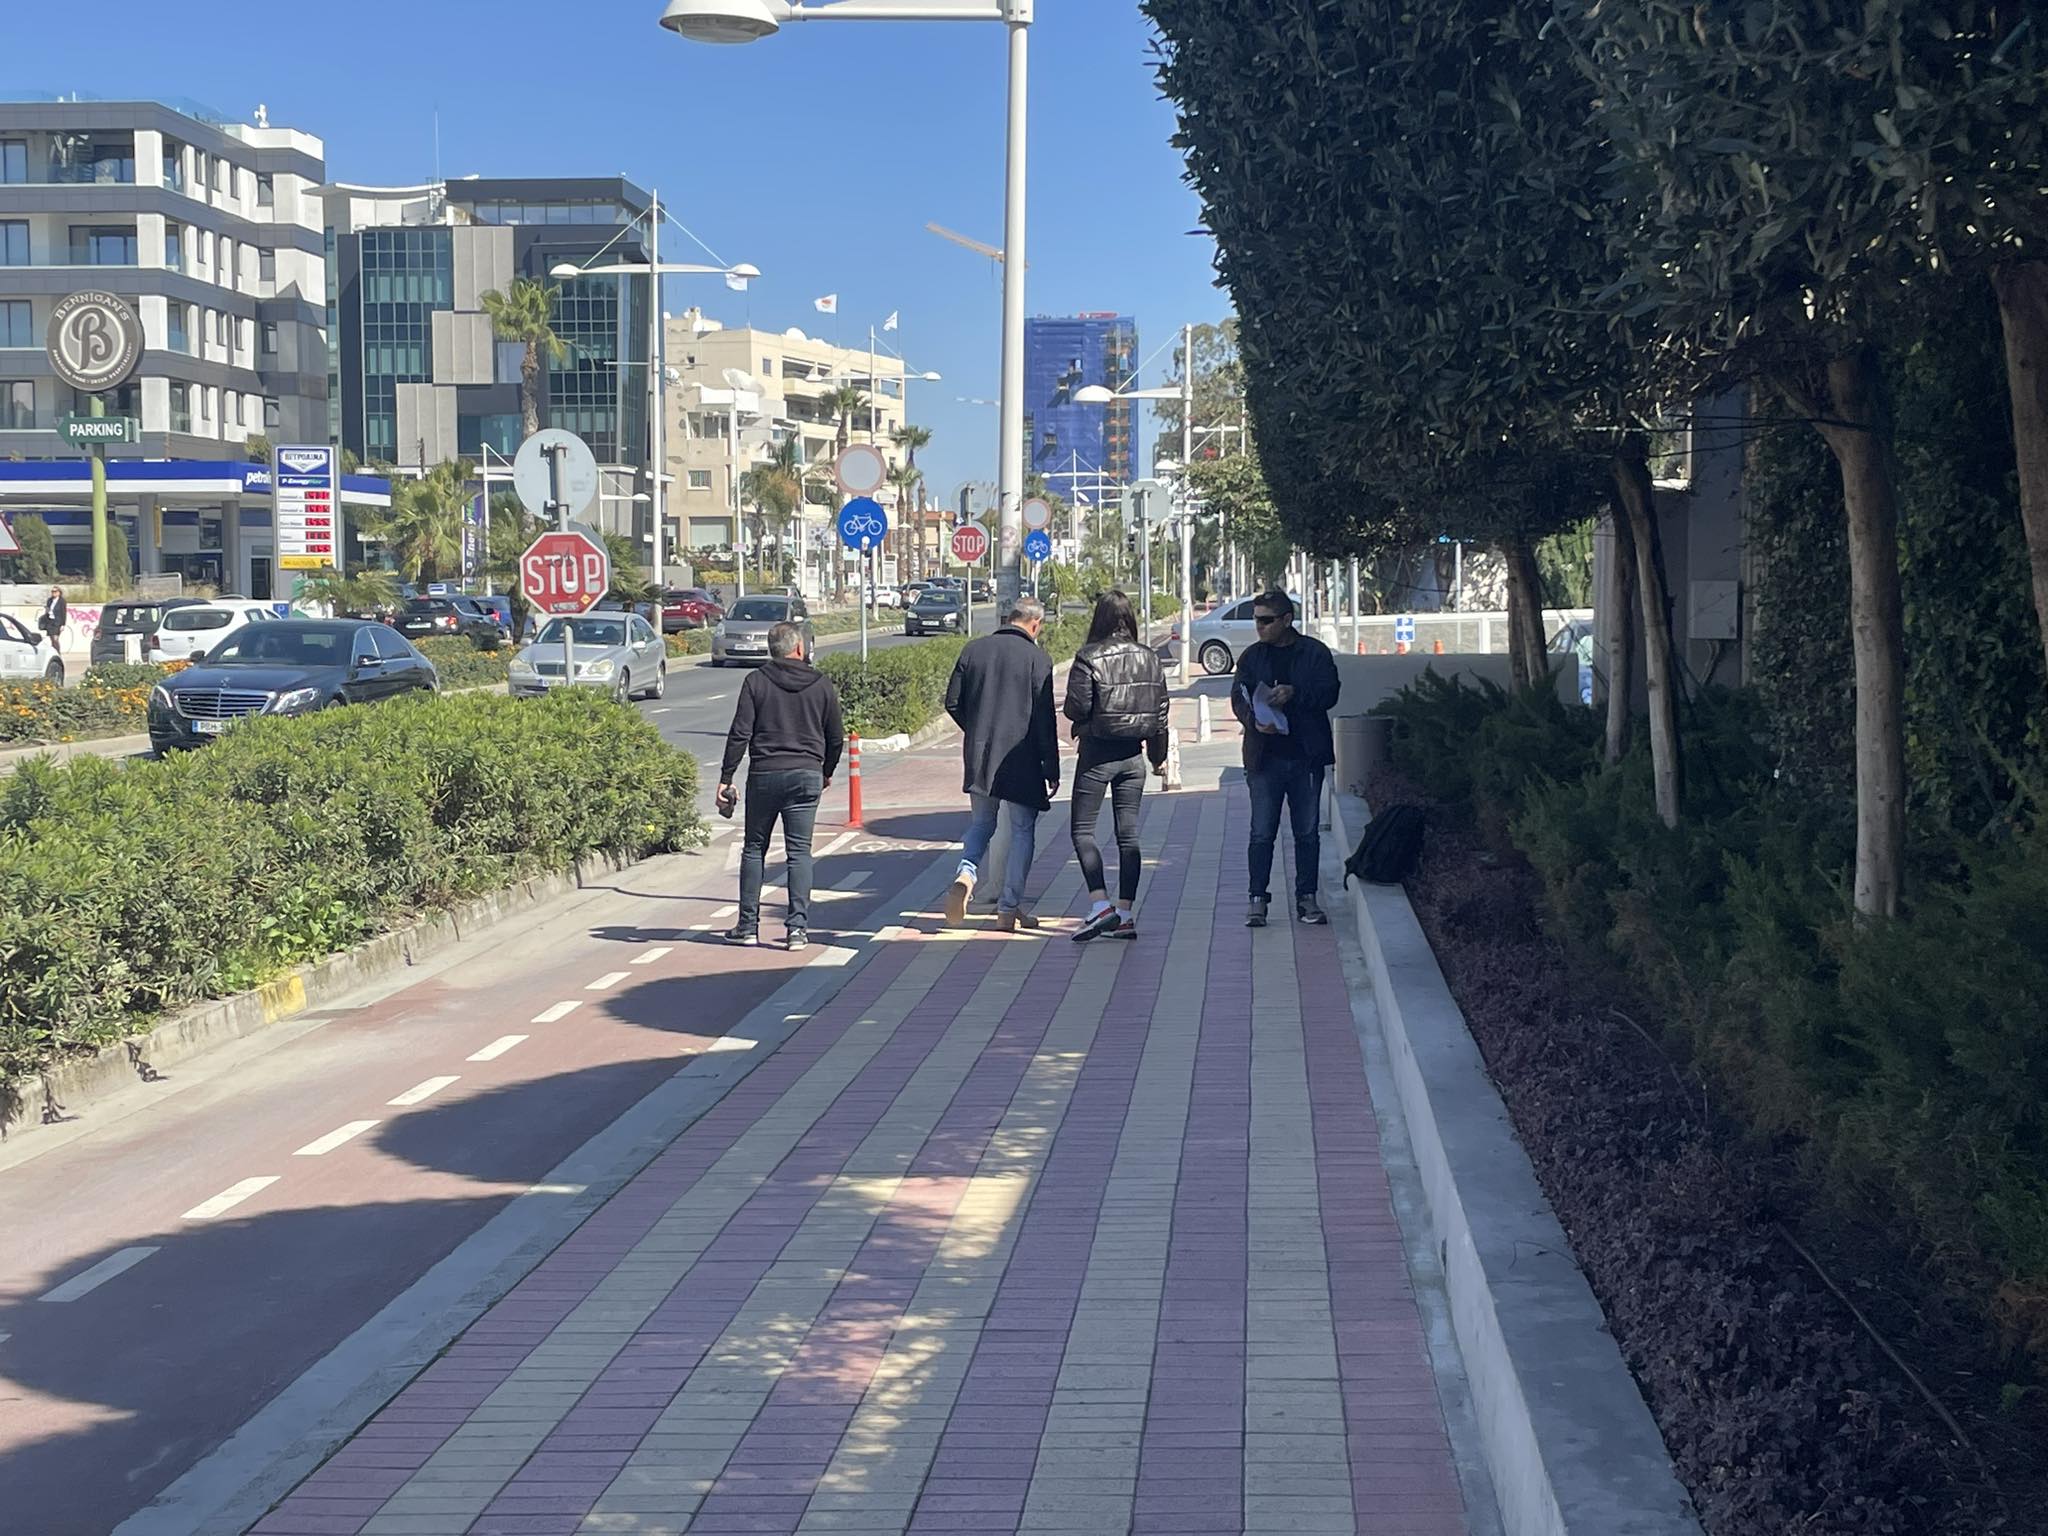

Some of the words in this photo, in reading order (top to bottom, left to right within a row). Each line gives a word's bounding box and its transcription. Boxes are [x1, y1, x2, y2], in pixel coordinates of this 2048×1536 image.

[55, 293, 131, 320] BENNIGAN'S
[69, 423, 123, 437] PARKING
[953, 535, 985, 553] STOP
[526, 554, 601, 595] STOP
